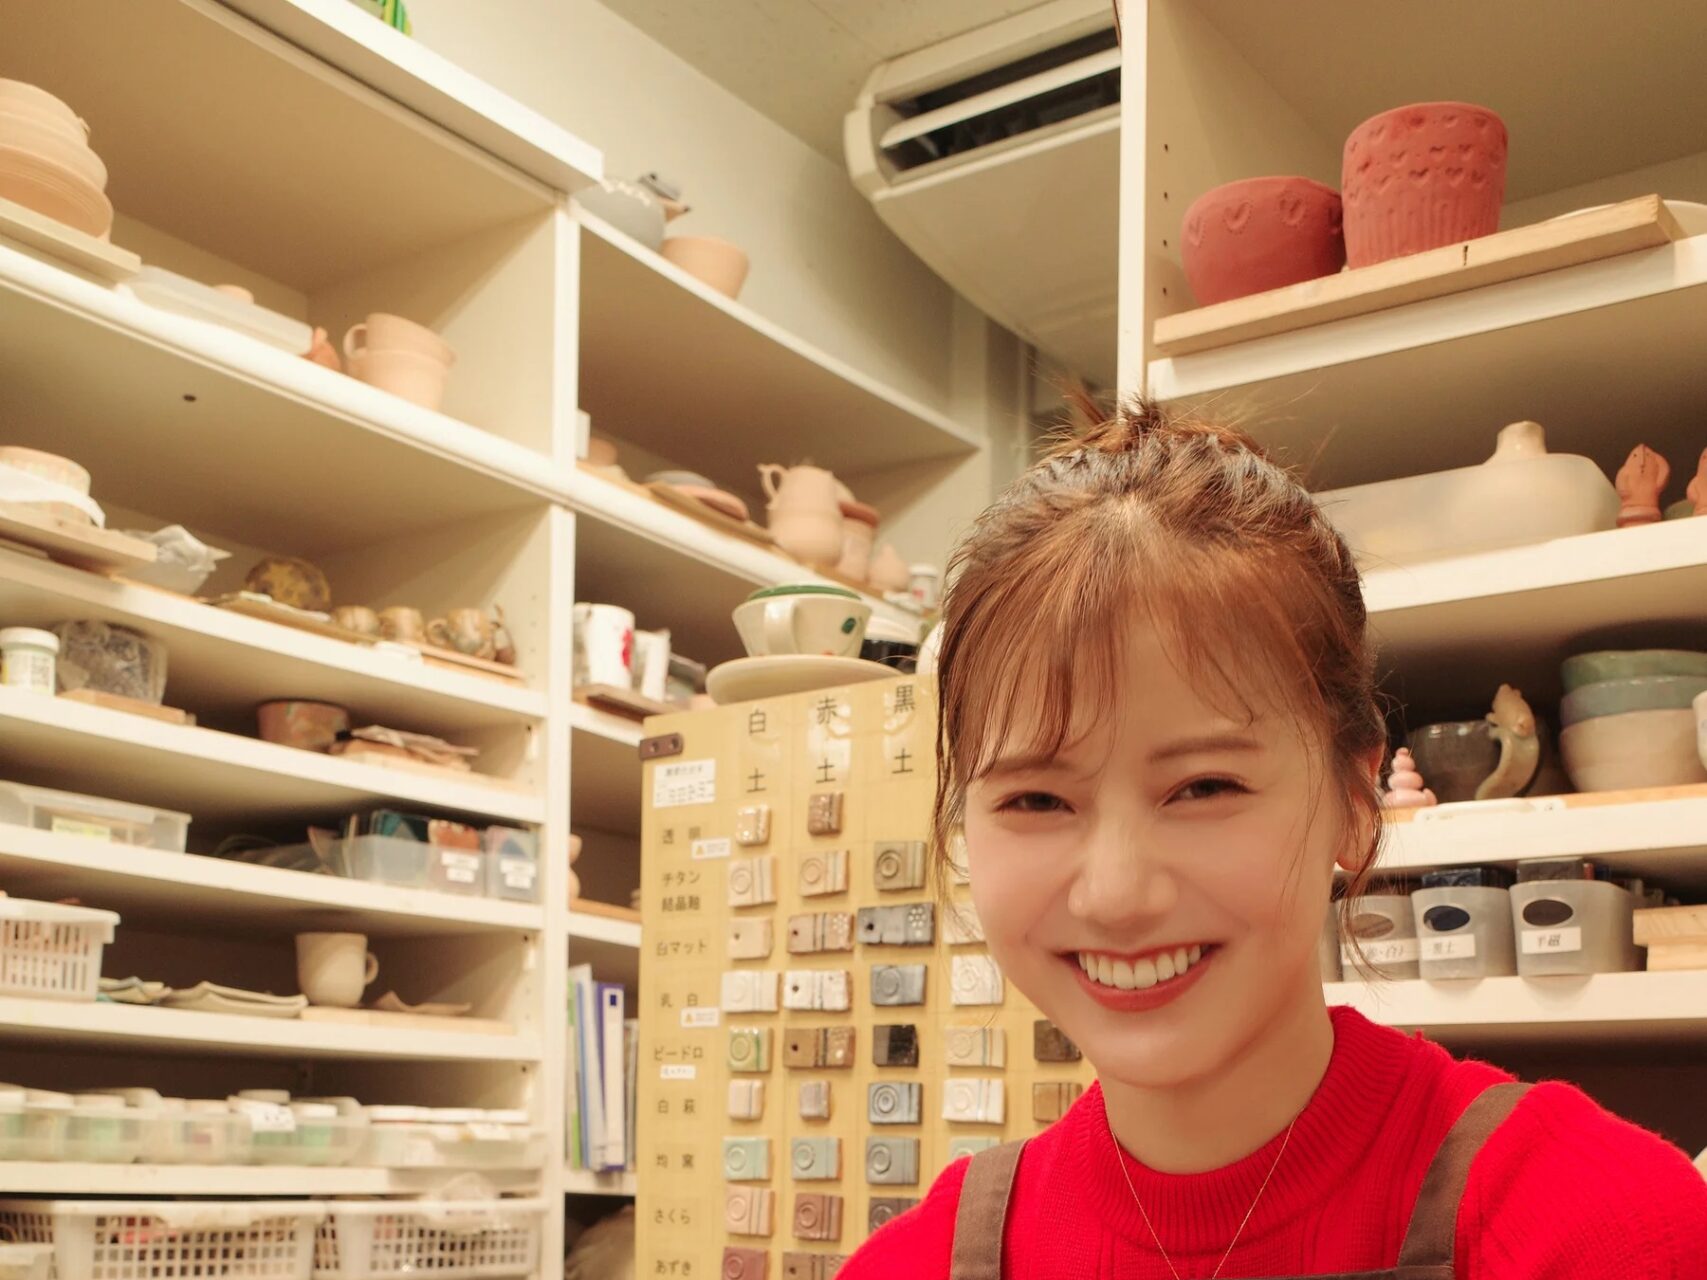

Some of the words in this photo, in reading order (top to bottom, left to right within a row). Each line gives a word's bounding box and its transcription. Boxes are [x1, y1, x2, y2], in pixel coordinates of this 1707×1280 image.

[892, 684, 915, 775] 黒土
[816, 697, 838, 784] 赤土
[747, 708, 767, 793] 白土
[662, 869, 701, 888] チタン
[656, 939, 707, 957] 白マット
[654, 1045, 703, 1061] ビードロ
[655, 1207, 691, 1224] さくら
[655, 1259, 691, 1277] あずき
